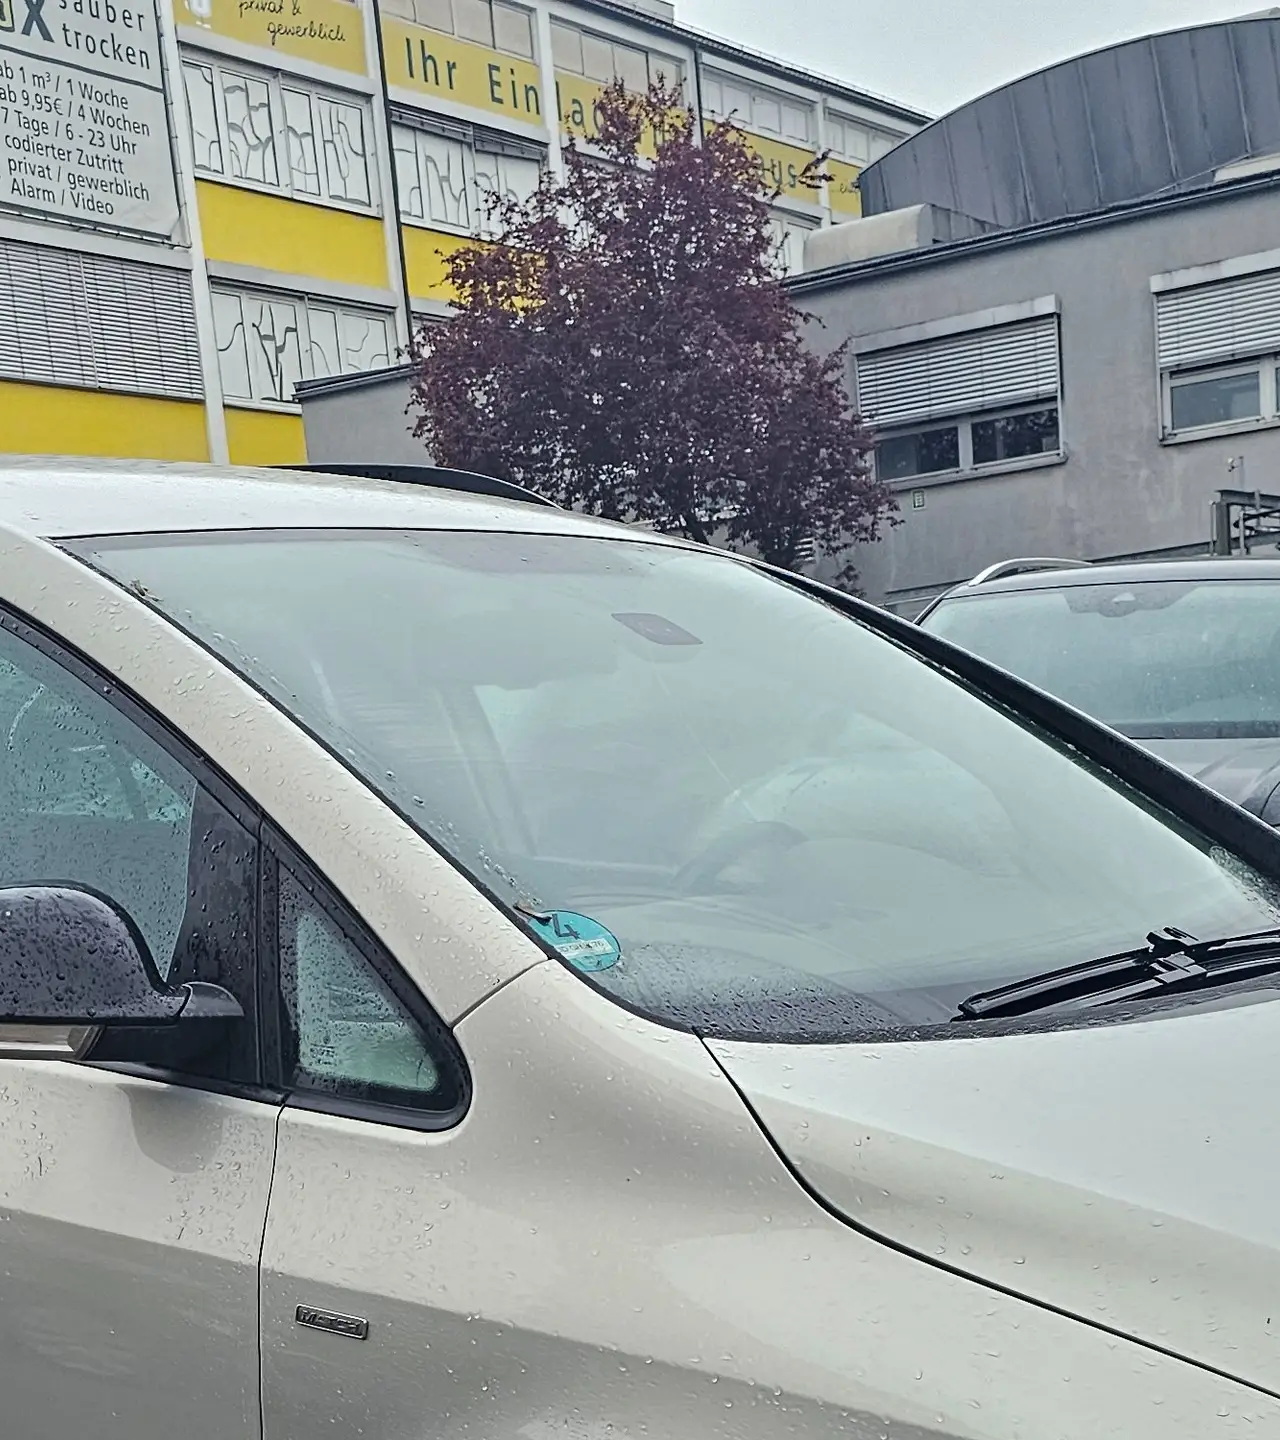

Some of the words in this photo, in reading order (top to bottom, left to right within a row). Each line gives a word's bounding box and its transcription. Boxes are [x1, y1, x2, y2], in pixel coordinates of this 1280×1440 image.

[62, 22, 151, 70] trocken
[266, 21, 347, 46] gewerblich
[406, 37, 457, 90] Ihr
[20, 67, 25, 83] 1
[32, 71, 51, 89] m³
[55, 75, 60, 92] /
[67, 79, 74, 96] 1
[78, 81, 128, 110] Woche
[0, 85, 17, 104] ab
[21, 90, 62, 118] 9,95€
[78, 104, 86, 121] 4
[90, 106, 150, 137] Wochen
[0, 106, 8, 123] 7
[13, 109, 49, 136] Tage
[66, 123, 73, 140] 6
[88, 128, 105, 148] 23
[111, 134, 136, 155] Uhr
[5, 132, 72, 162] codierter
[77, 148, 124, 174] Zutritt
[8, 156, 51, 182] privat
[68, 169, 149, 201] gewerblich
[11, 177, 55, 202] Alarm
[69, 191, 114, 216] Video
[551, 913, 582, 940] 4
